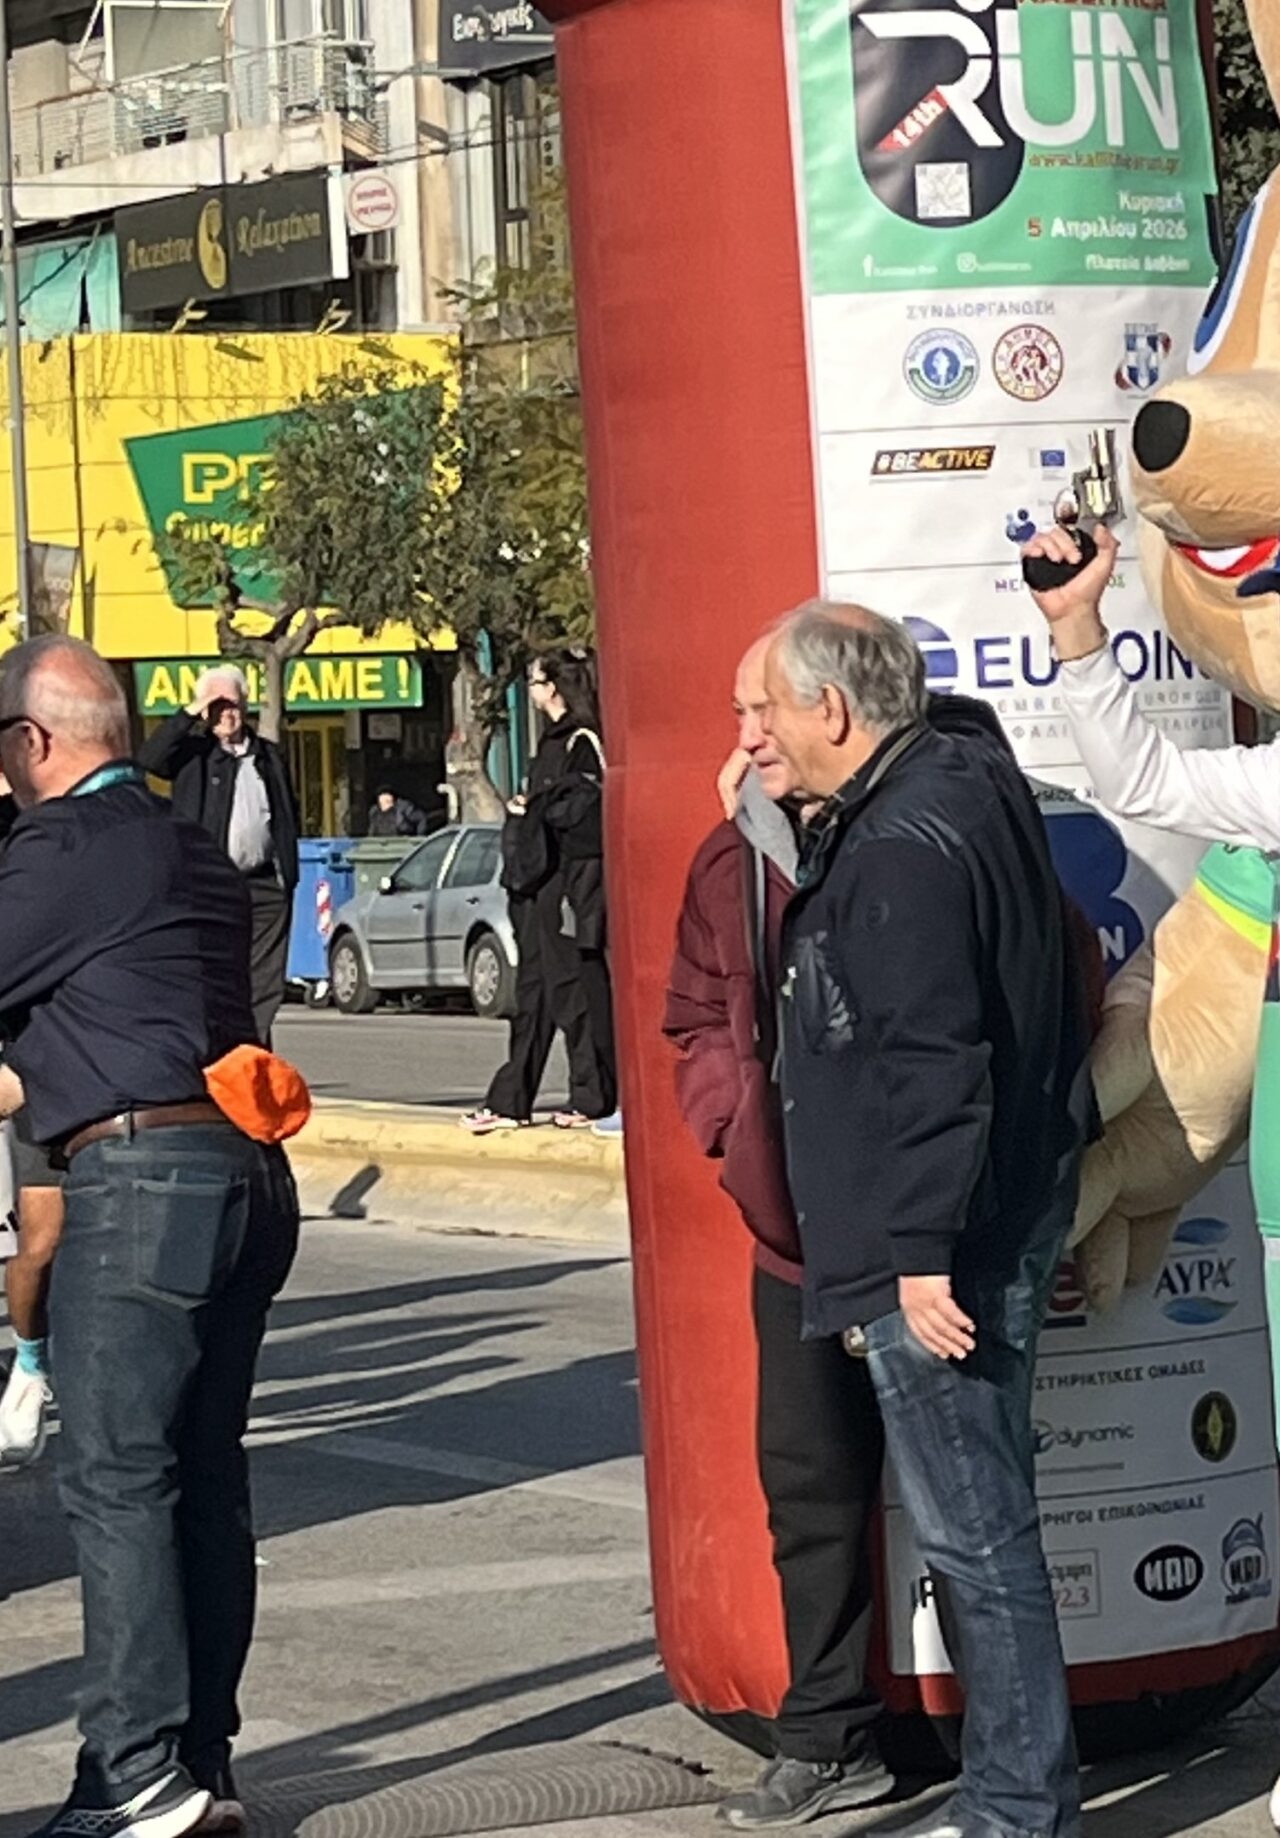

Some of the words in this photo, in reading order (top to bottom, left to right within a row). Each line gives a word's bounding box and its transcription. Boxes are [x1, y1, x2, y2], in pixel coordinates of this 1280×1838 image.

[858, 9, 1180, 150] RUN
[1027, 216, 1043, 238] 5
[1051, 216, 1138, 241] Απριλίου
[1141, 217, 1188, 240] 2026
[906, 300, 1056, 320] ΣΥΝΔΙΟΡΓΑΝΩΣΗ
[1035, 1366, 1144, 1391] ΣΤΗΡΙΚΤΙΚΕΣ
[1042, 1509, 1094, 1526] ΡΗΓΟΙ
[1144, 1555, 1198, 1592] MAD
